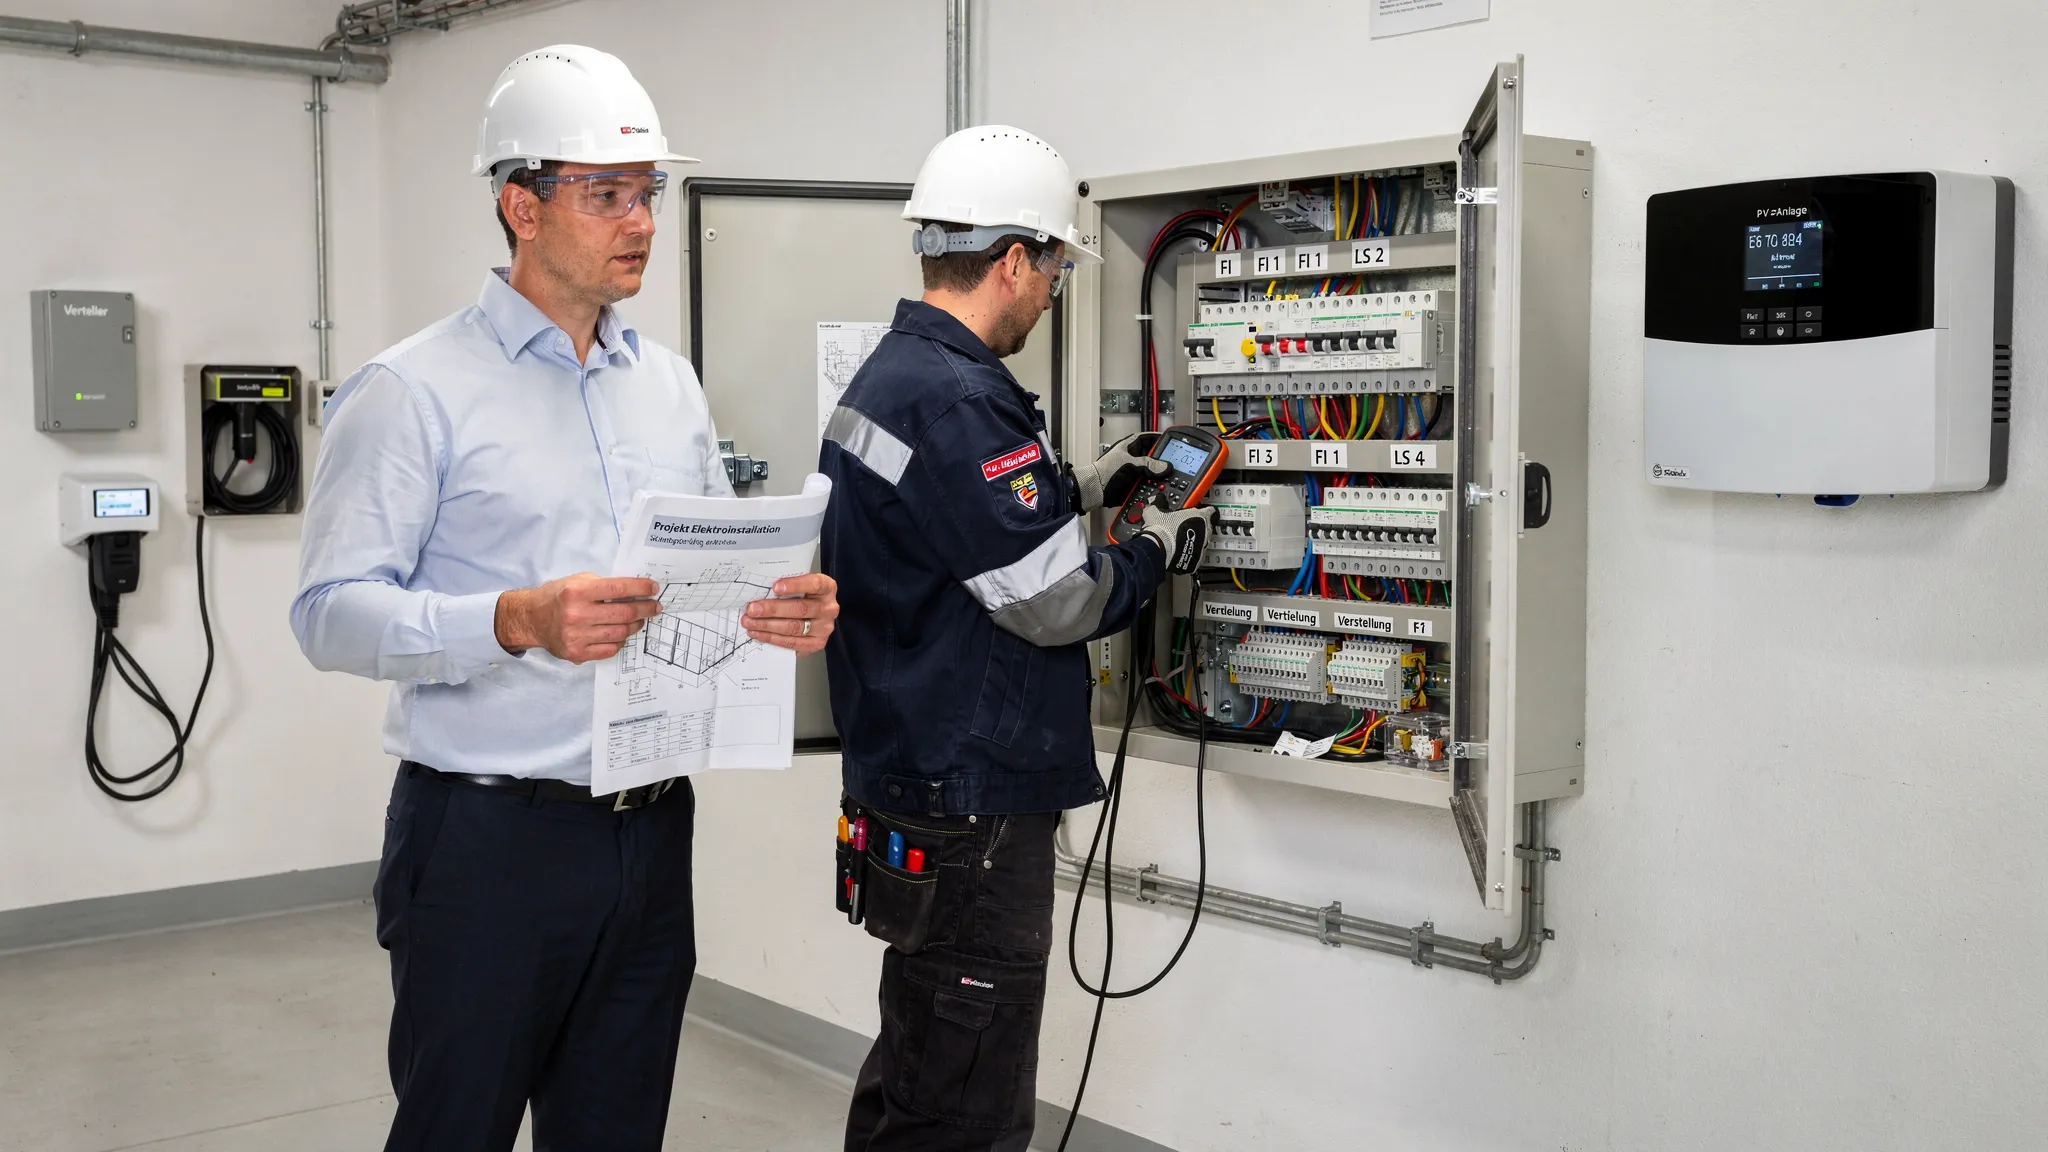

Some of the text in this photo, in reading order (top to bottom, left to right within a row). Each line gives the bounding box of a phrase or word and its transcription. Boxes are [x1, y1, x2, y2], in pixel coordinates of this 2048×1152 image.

[1757, 208, 1770, 218] PV
[1298, 252, 1321, 269] FI 1
[1354, 247, 1384, 264] LS 2
[1220, 259, 1232, 275] FI
[1258, 256, 1279, 272] FI 1
[1248, 448, 1273, 464] FI 3
[1315, 449, 1339, 465] FI 1
[1394, 449, 1426, 466] LS 4
[653, 521, 781, 535] Projekt Elektroinstallation
[1337, 615, 1392, 633] Verstellung
